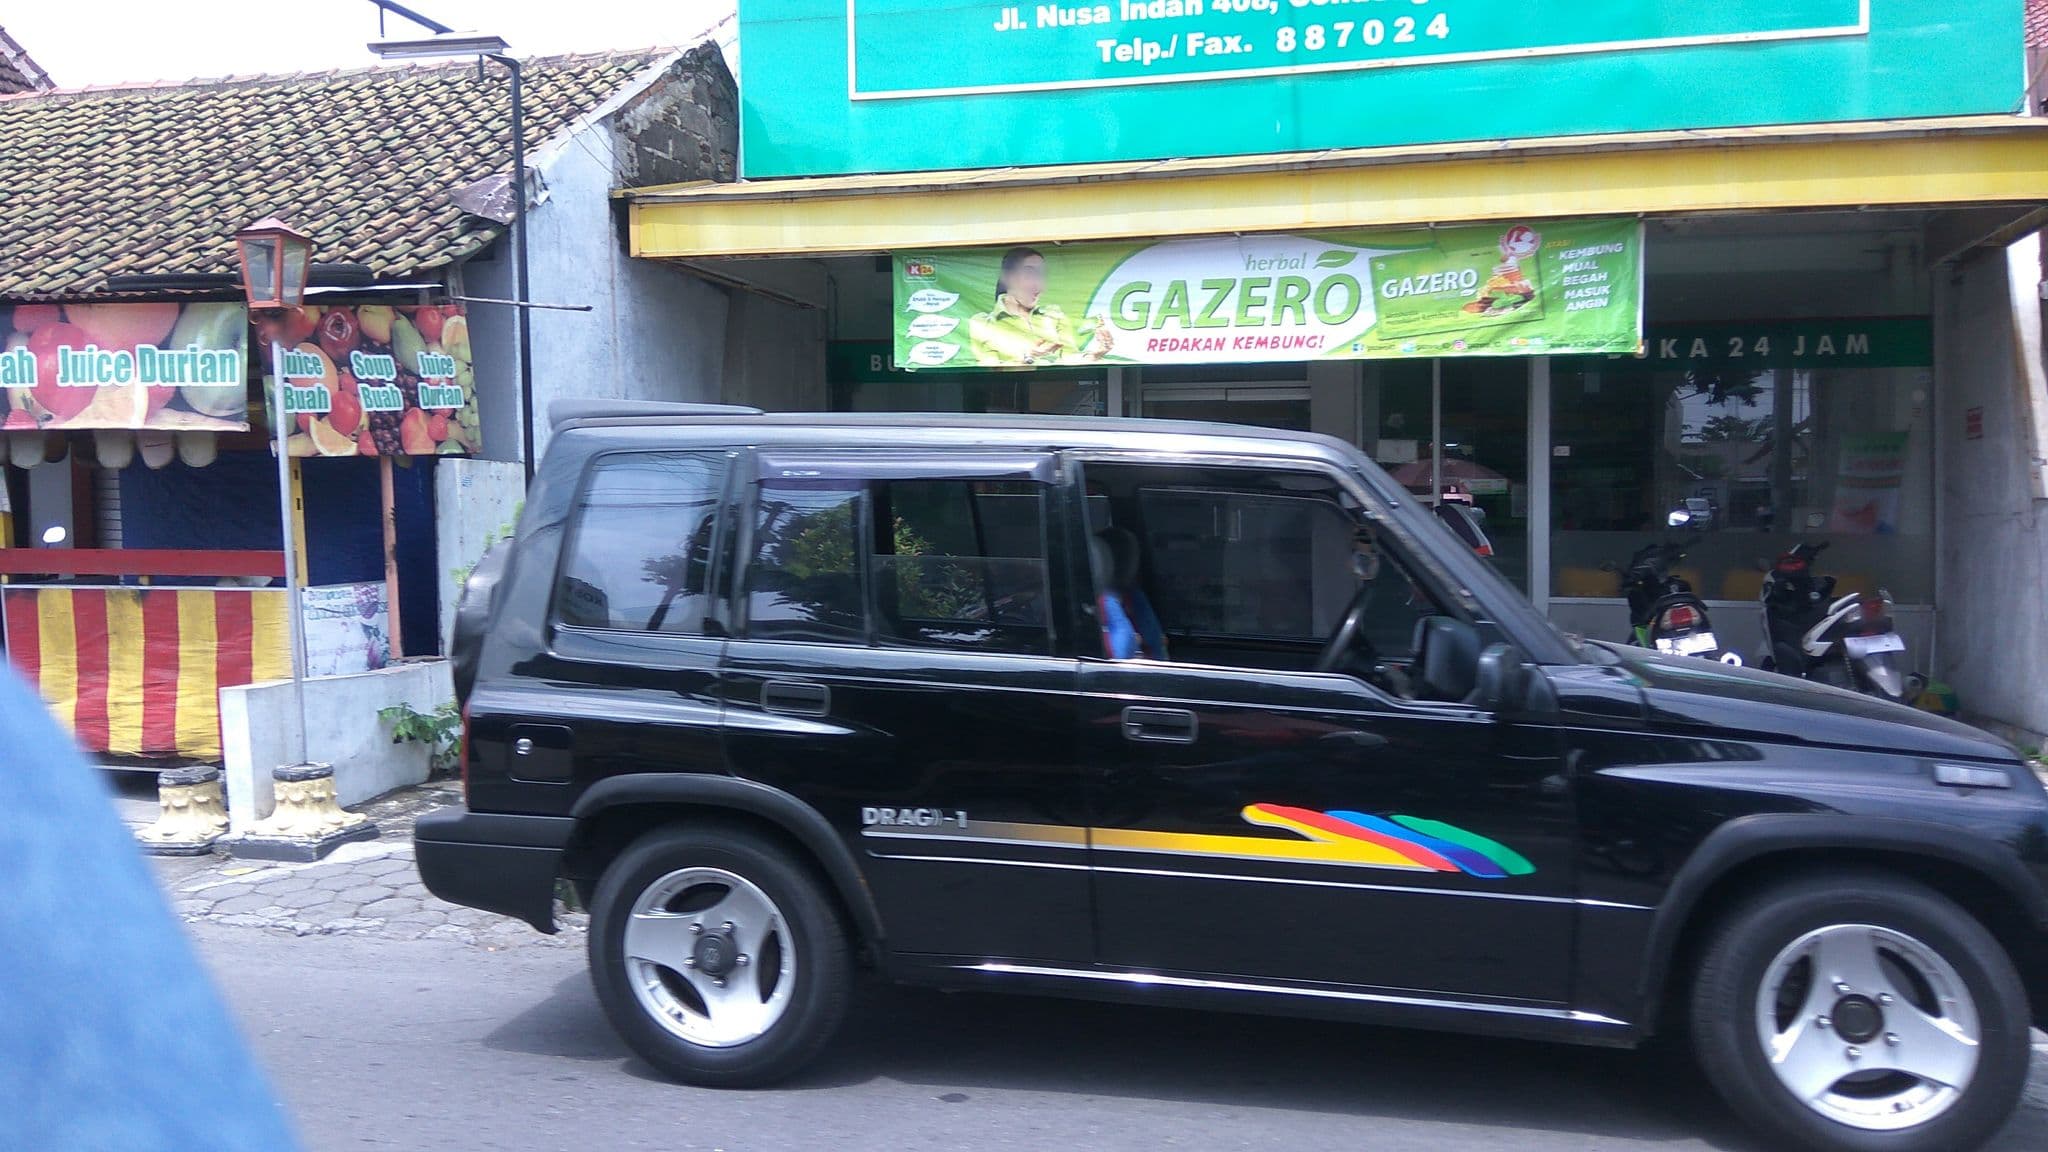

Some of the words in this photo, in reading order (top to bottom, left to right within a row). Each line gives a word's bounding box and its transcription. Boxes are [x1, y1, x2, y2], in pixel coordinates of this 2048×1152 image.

[993, 7, 1027, 32] Jl.
[1036, 4, 1111, 29] Nusa
[1186, 31, 1253, 56] Fax.
[1246, 252, 1307, 272] herbal
[1559, 242, 1624, 260] KEMBUNG
[1562, 260, 1599, 274] MUAL
[1563, 272, 1608, 287] BEGAH
[1381, 268, 1478, 299] GAZERO
[1564, 285, 1611, 300] MASUK
[1109, 272, 1362, 331] GAZERO
[1566, 297, 1609, 312] ANGIN
[1147, 336, 1226, 353] REDAKAN
[1232, 335, 1325, 351] KEMBUNG!
[1728, 335, 1771, 358] 24
[1793, 333, 1869, 357] JAM
[58, 345, 133, 386] Juice
[136, 345, 239, 386] Durian
[351, 351, 397, 381] Soup
[416, 353, 456, 378] Juice
[283, 384, 330, 412] Buah
[359, 384, 404, 411] Buah
[418, 384, 465, 409] Durian
